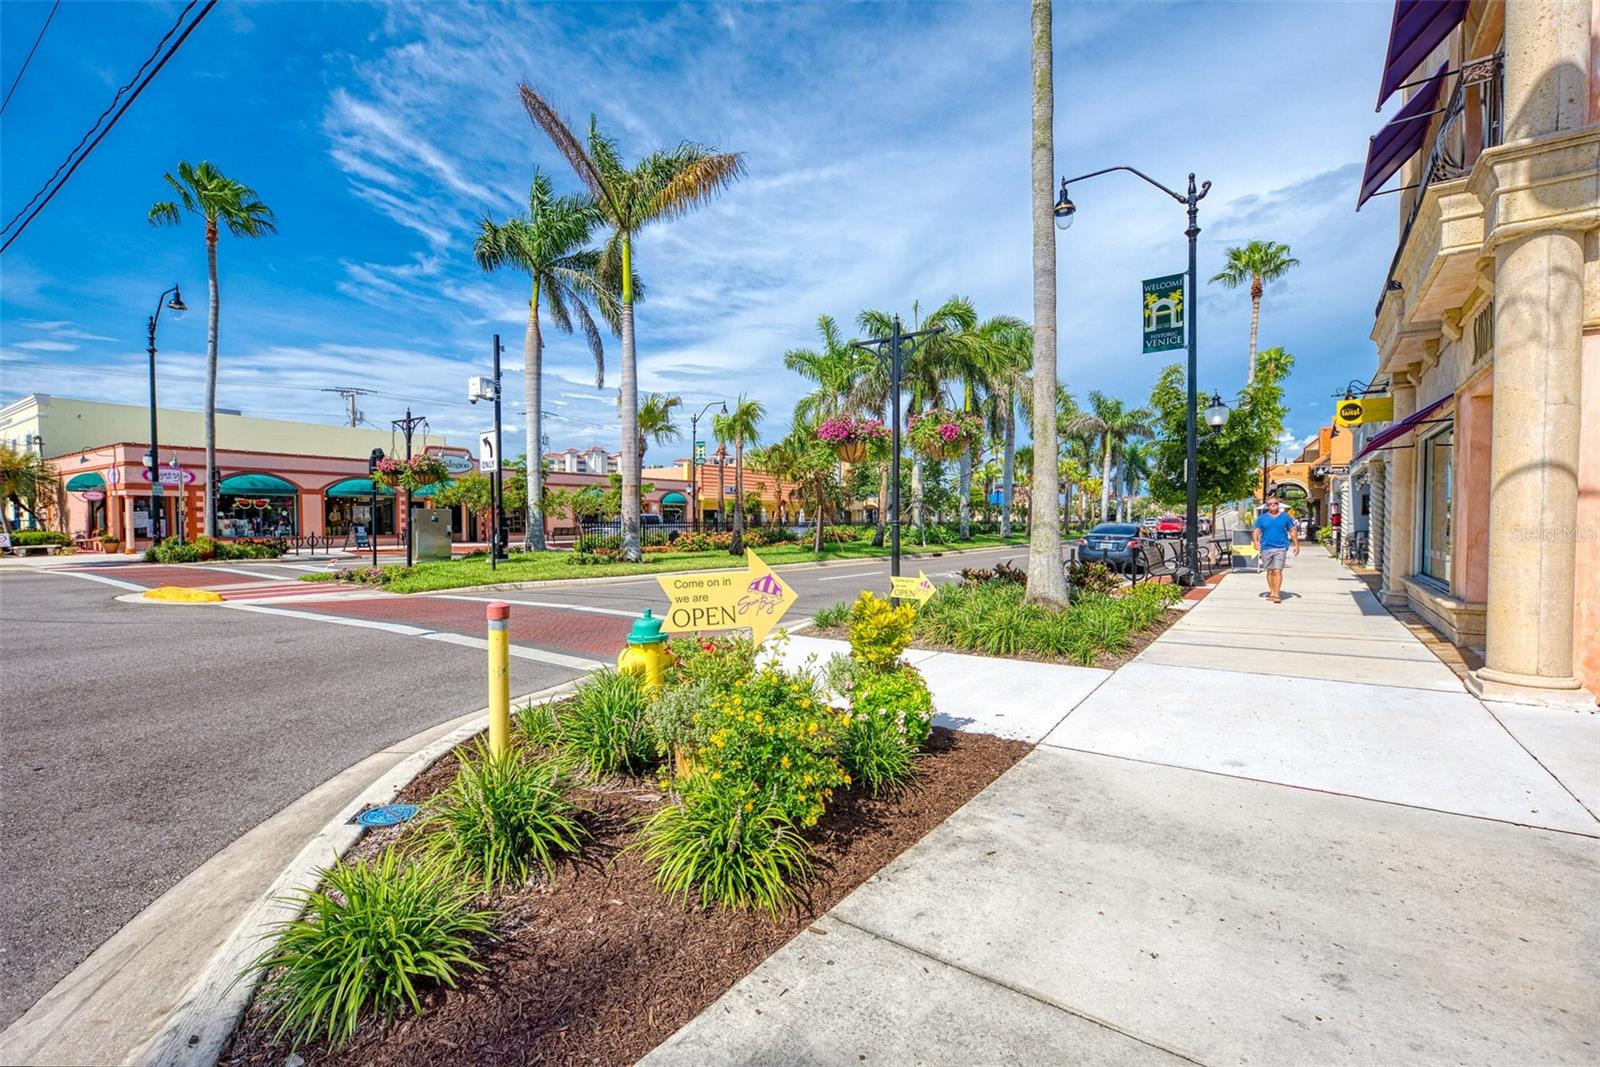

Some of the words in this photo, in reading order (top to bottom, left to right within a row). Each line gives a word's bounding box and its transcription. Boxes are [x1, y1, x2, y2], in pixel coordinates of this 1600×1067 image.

[1144, 279, 1184, 291] WELCOME
[1150, 331, 1178, 339] HISTORIC
[1146, 335, 1182, 347] VENICE
[481, 461, 495, 469] ONLY
[673, 579, 704, 589] Come
[706, 579, 720, 588] on
[722, 577, 732, 587] in
[675, 595, 690, 604] we
[692, 593, 709, 603] are
[894, 589, 915, 597] OPEN
[672, 605, 737, 628] OPEN
